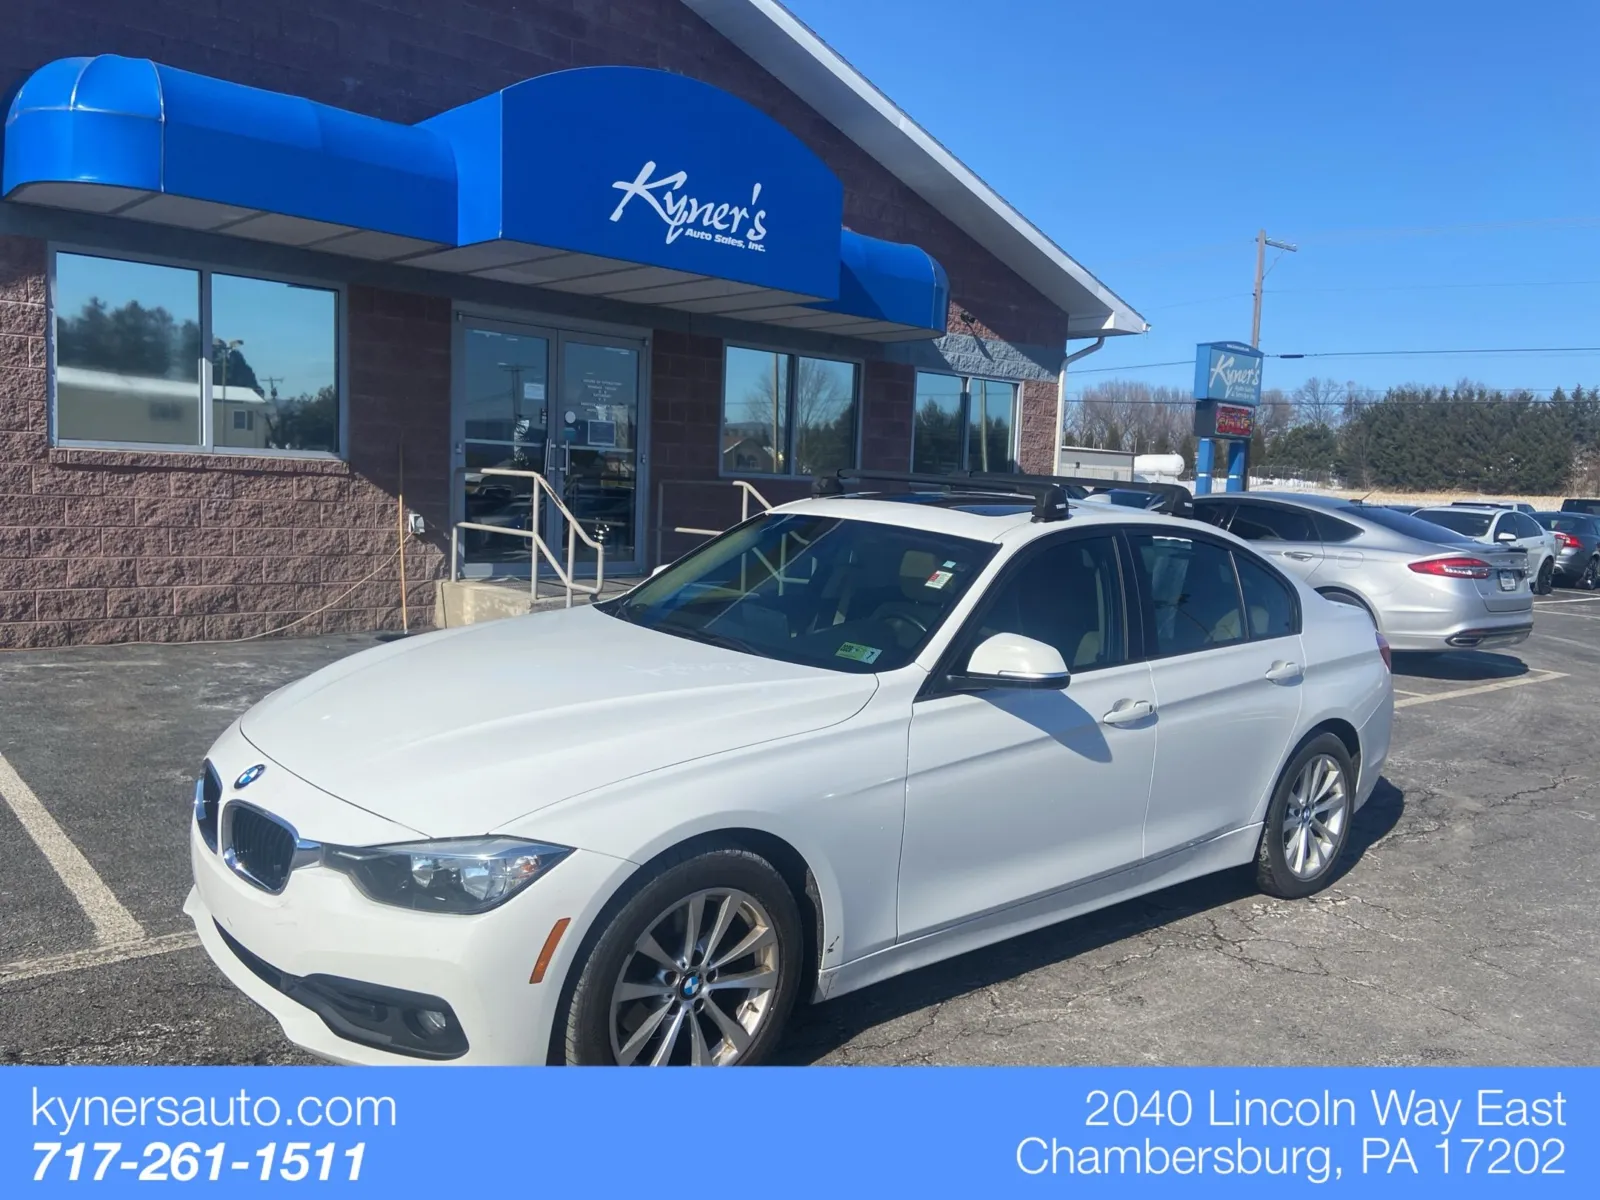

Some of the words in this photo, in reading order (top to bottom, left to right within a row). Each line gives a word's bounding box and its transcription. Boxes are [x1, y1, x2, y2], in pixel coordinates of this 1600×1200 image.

[609, 160, 767, 245] Kyner's
[685, 228, 712, 241] Auto
[714, 234, 745, 249] Sales,
[748, 241, 766, 252] Inc.
[1209, 354, 1260, 399] Kyner's
